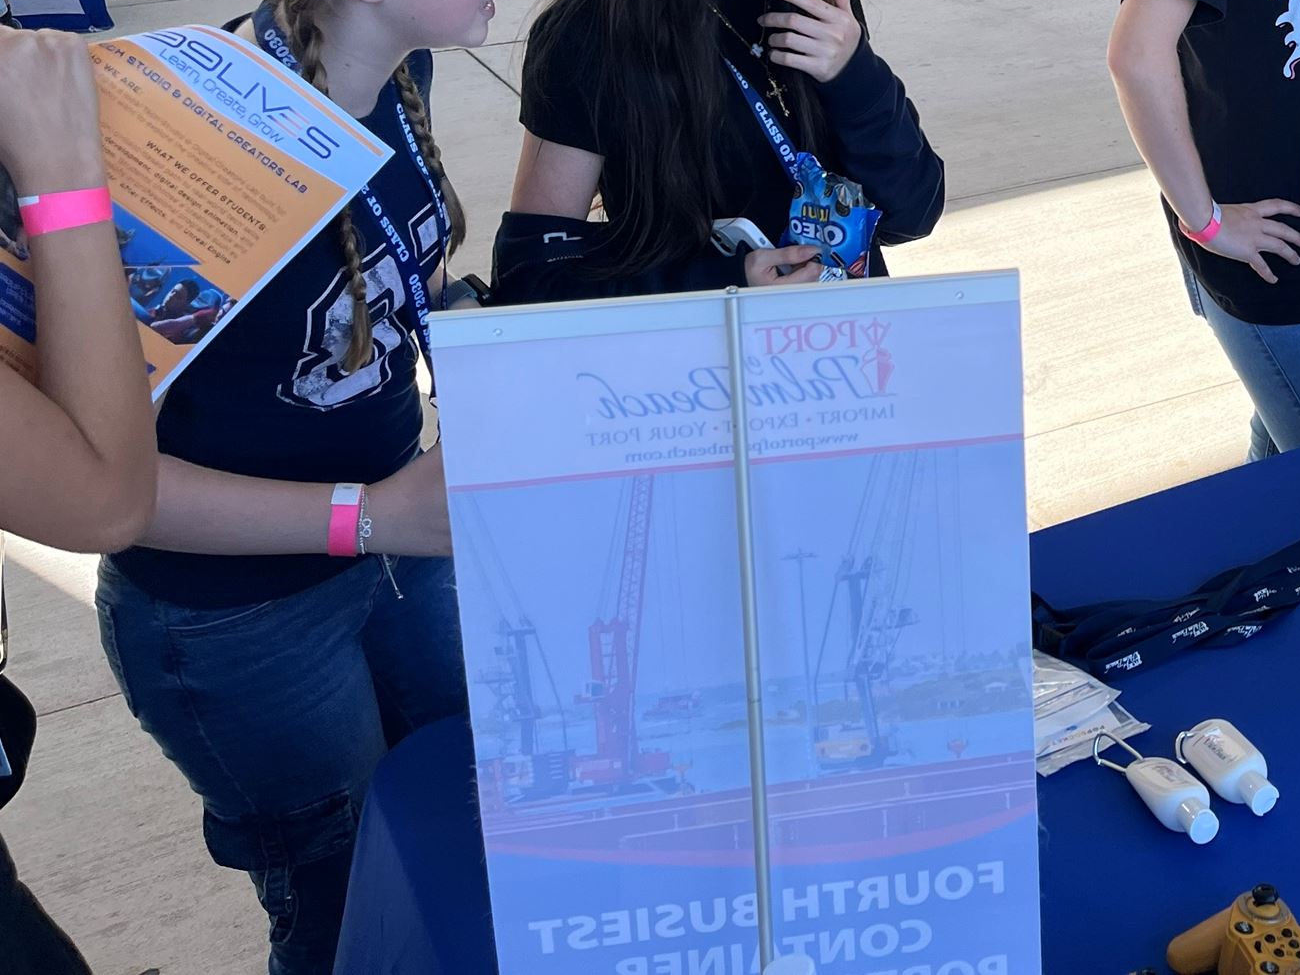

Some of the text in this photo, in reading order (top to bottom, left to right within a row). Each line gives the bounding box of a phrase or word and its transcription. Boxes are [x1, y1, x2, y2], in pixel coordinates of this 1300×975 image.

[264, 28, 298, 69] 2030
[127, 55, 172, 92] STUDIO
[182, 96, 224, 134] DIGITAL
[226, 130, 285, 177] CREATORS
[159, 48, 285, 144] Learn, Create, Grow
[396, 102, 418, 154] CLASS
[755, 101, 784, 145] CLASS
[779, 144, 796, 164] OF
[189, 172, 220, 198] OFFER
[366, 191, 410, 263] CLASS OF
[408, 273, 427, 308] 2030
